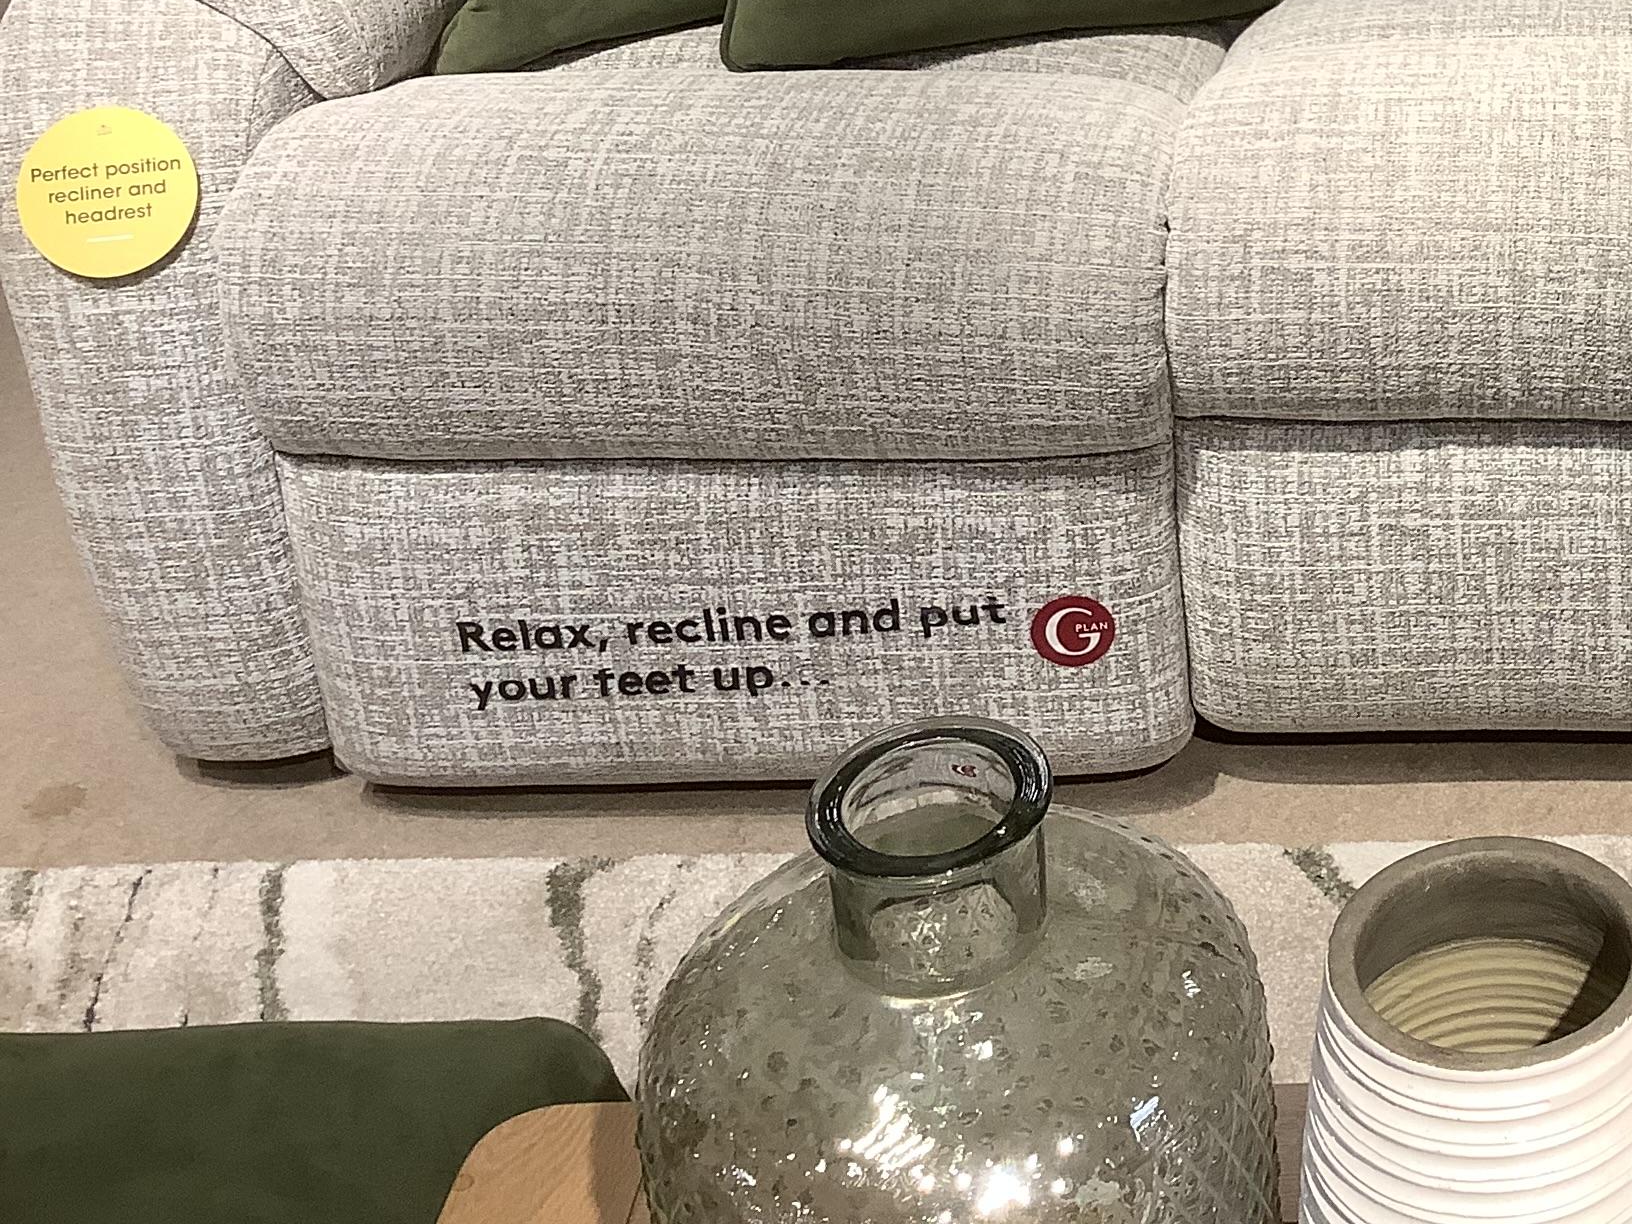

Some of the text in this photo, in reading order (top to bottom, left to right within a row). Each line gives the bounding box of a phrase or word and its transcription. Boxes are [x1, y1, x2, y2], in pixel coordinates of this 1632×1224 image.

[31, 157, 181, 183] Perfect position
[49, 179, 166, 203] recliner and
[66, 203, 152, 224] headrest
[456, 596, 1007, 653] Relax, recline and put
[1045, 606, 1101, 656] G
[1075, 621, 1109, 633] PLAN
[469, 664, 830, 710] your feet up...
